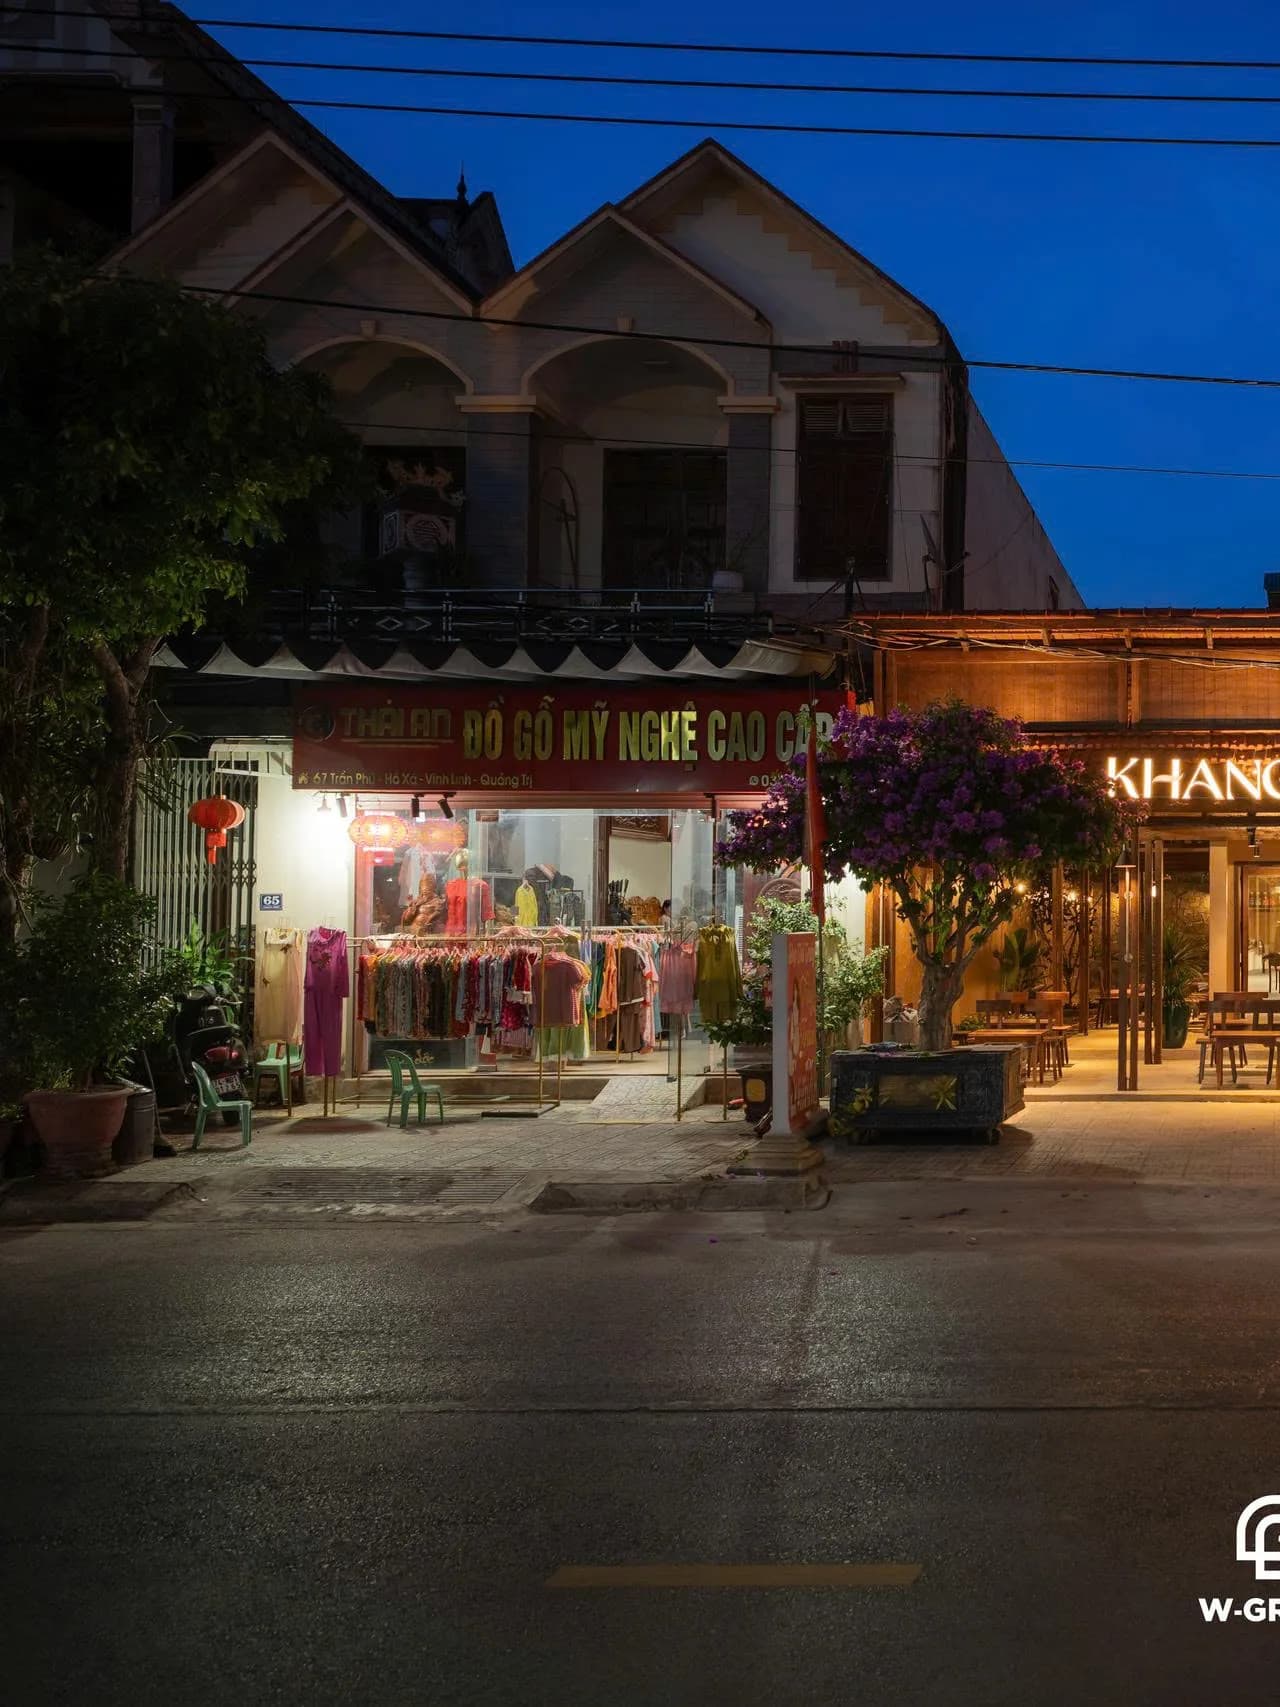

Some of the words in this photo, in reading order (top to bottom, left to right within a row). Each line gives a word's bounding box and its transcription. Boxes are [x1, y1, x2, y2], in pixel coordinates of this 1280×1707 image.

[463, 694, 505, 760] ĐỒ
[513, 695, 556, 761] GỖ
[563, 699, 611, 760] MỸ
[619, 700, 698, 772] NGHỆ
[707, 708, 766, 761] CAO
[313, 773, 328, 785] 67
[480, 772, 520, 788] Quảng
[263, 895, 280, 905] 65
